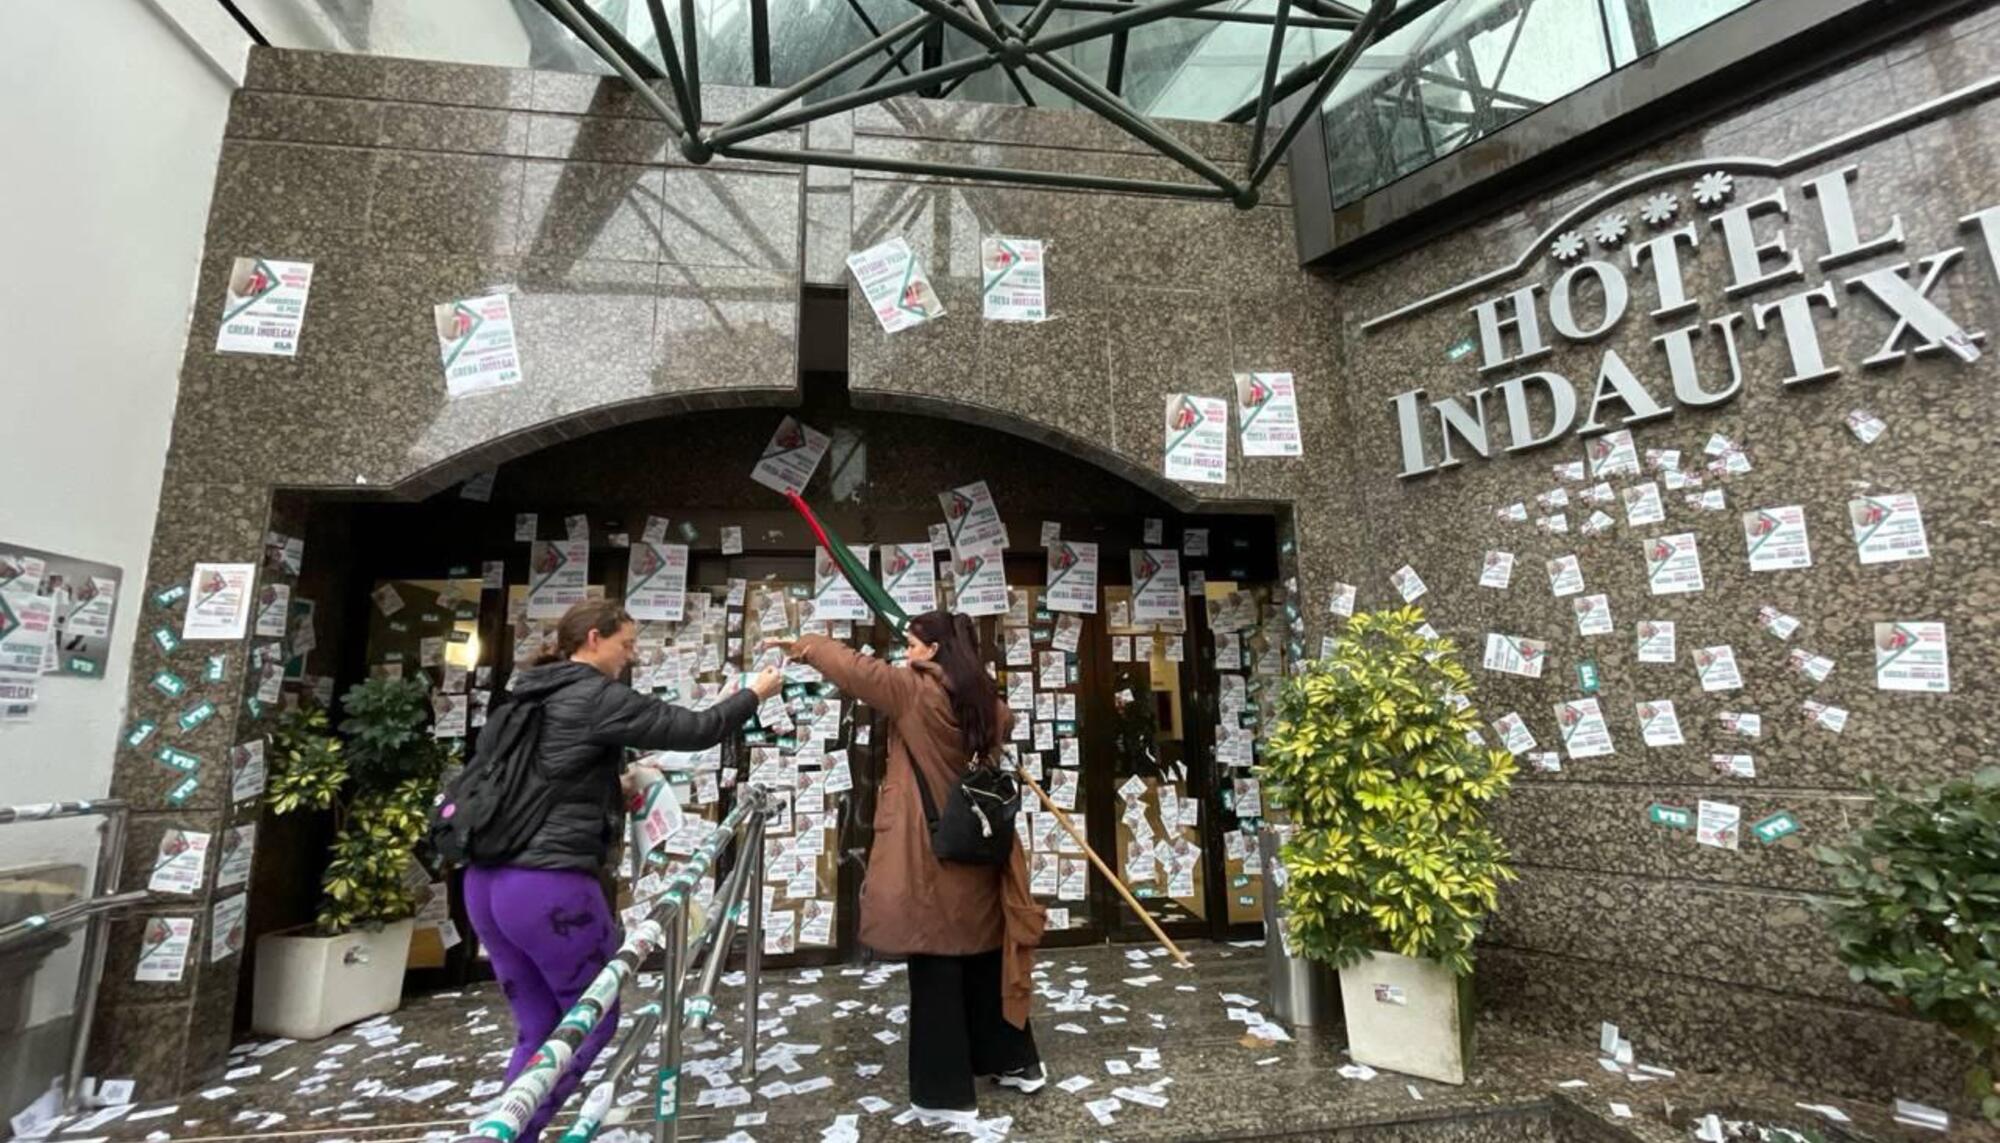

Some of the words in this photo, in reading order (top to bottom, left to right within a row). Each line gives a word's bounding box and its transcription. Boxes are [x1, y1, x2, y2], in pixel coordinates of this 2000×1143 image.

[1468, 166, 1907, 372] HOTEL
[159, 586, 185, 602] ELA
[156, 630, 175, 650] ELA
[156, 674, 179, 692] ELA
[1581, 666, 1595, 688] ELA
[184, 705, 211, 723] ELA
[130, 725, 153, 745] ELA
[671, 774, 689, 783] ELA
[172, 778, 198, 799] ELA
[1658, 809, 1687, 824] ELA
[1760, 817, 1793, 836] ELA
[660, 1076, 677, 1115] ELA
